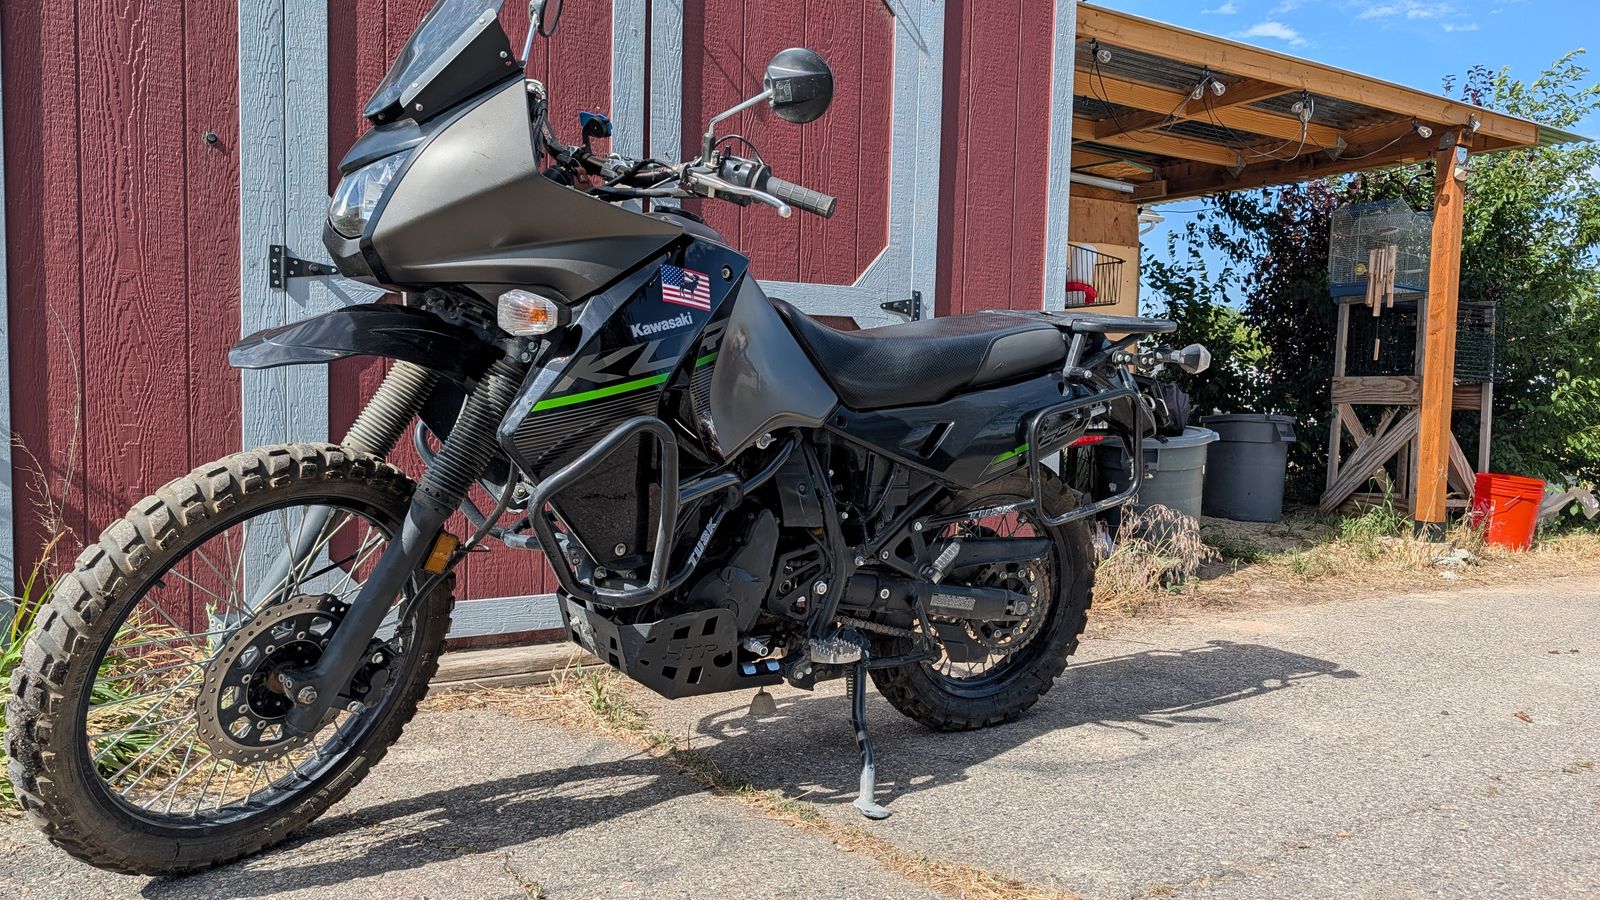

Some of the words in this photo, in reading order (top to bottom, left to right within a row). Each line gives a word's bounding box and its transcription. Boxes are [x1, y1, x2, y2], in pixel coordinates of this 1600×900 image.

[630, 312, 693, 338] Kawasaki
[967, 504, 1017, 519] TUSK
[687, 516, 717, 568] TUSK
